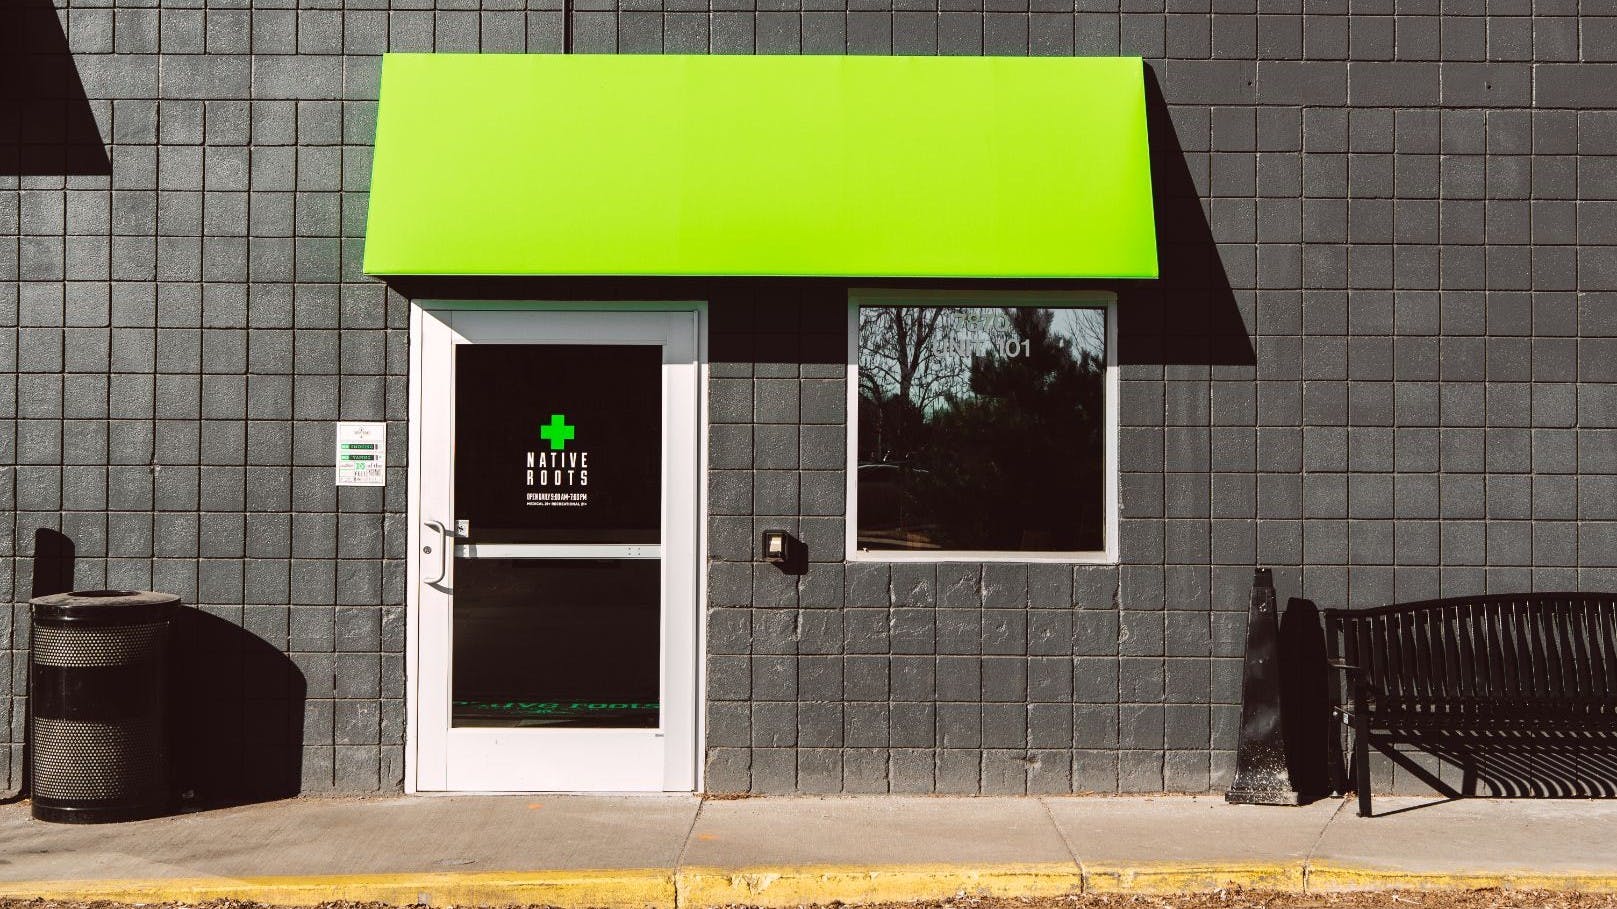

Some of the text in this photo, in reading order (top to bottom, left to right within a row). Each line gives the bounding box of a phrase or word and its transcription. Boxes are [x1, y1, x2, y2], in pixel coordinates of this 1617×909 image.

[953, 313, 1012, 332] 7870
[932, 338, 1030, 358] UNIT 101
[527, 452, 588, 468] NATIVE
[526, 470, 588, 486] ROOTS
[527, 493, 539, 501] OPEN
